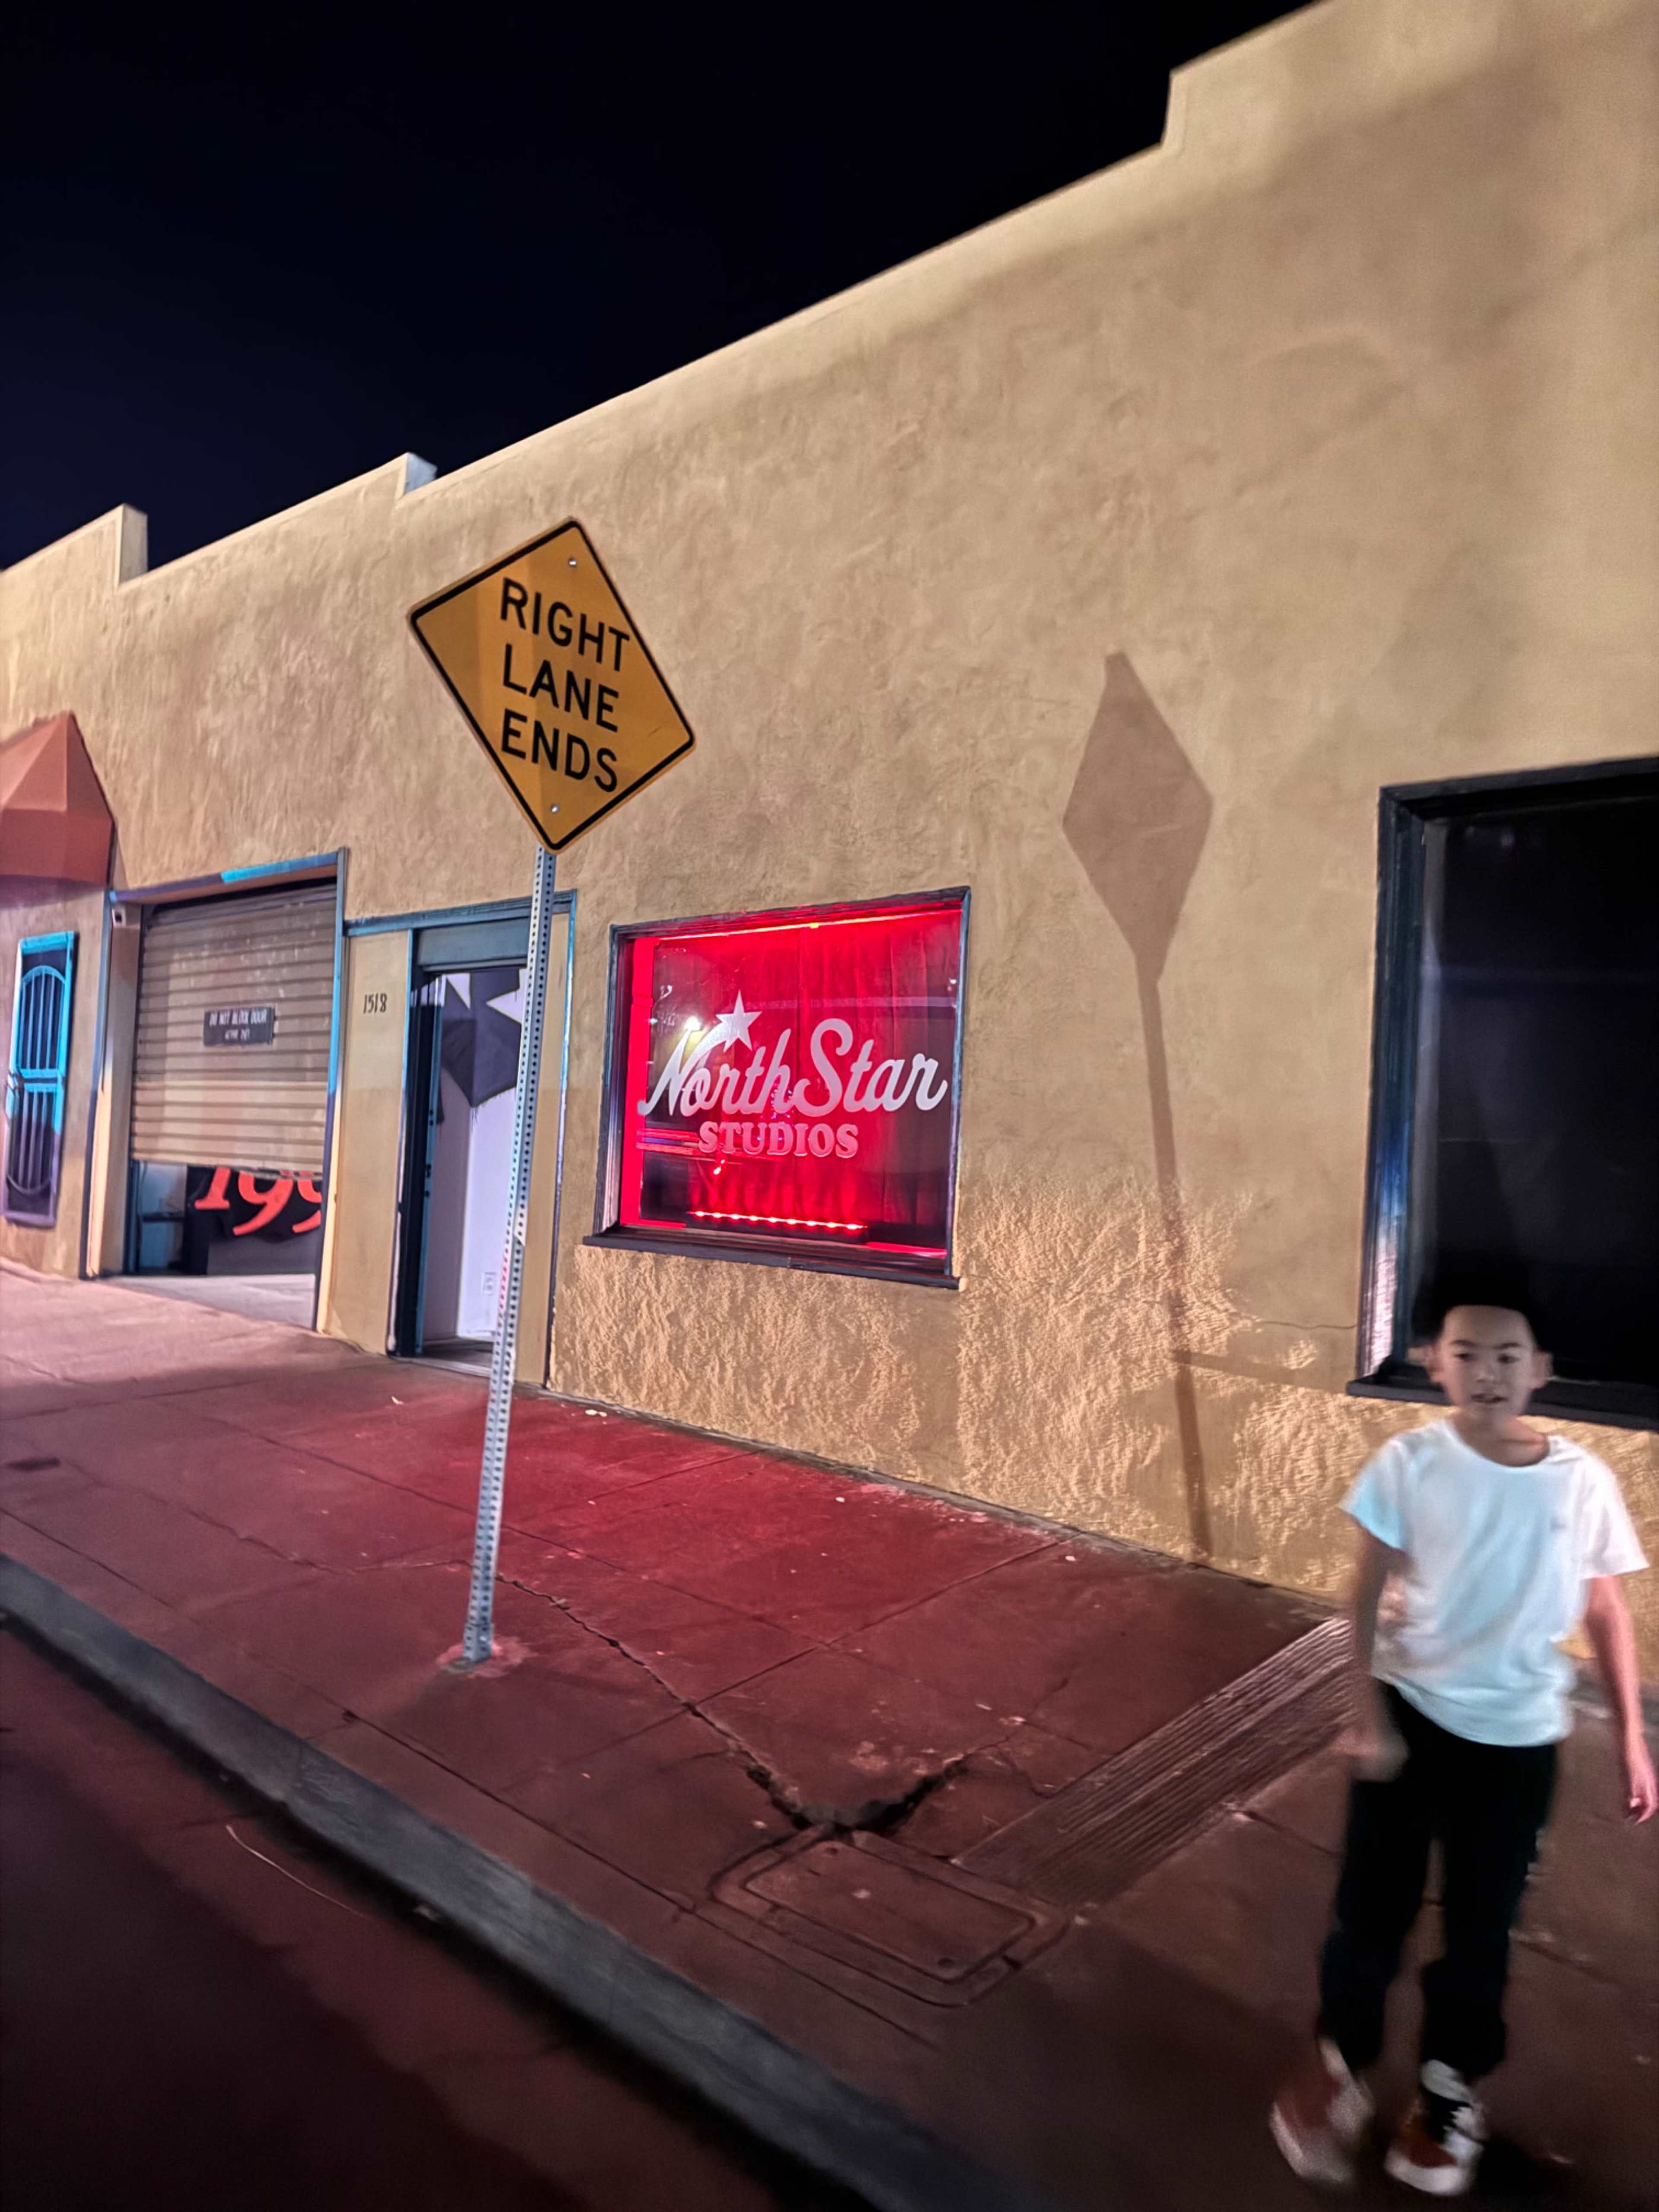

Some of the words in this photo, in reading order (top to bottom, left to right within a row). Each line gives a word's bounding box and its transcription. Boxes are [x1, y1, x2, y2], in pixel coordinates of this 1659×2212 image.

[500, 578, 629, 671] RIGHT
[503, 644, 619, 732] LANE
[501, 709, 618, 792] ENDS
[363, 993, 387, 1014] 1518
[637, 1022, 792, 1117] North
[791, 1018, 948, 1117] Star
[699, 1120, 858, 1158] STUDIOS
